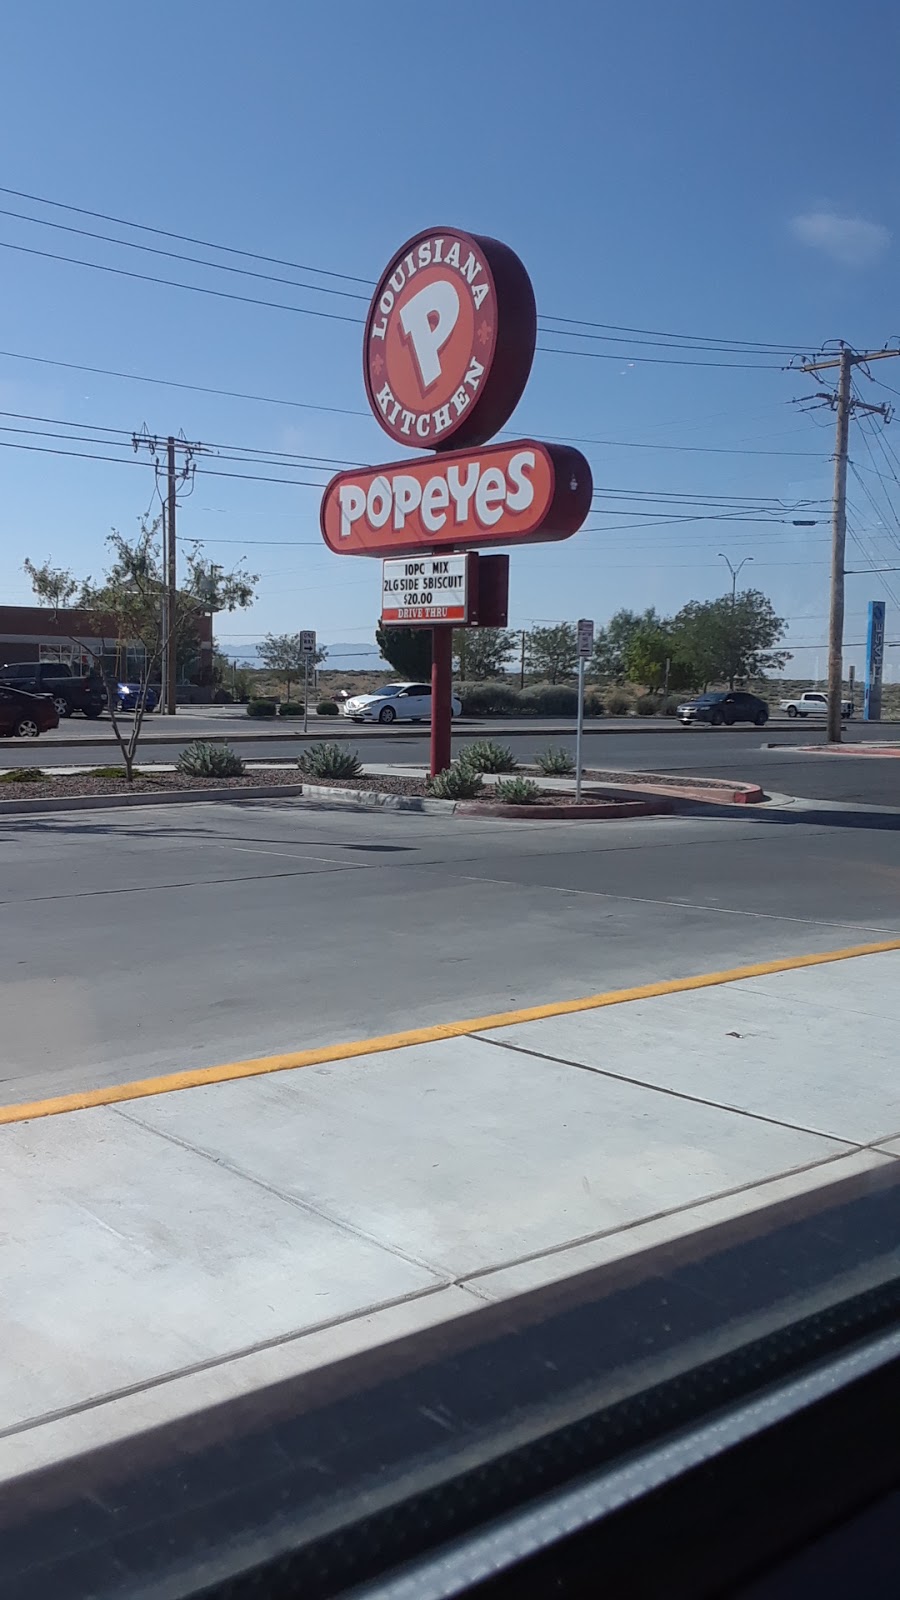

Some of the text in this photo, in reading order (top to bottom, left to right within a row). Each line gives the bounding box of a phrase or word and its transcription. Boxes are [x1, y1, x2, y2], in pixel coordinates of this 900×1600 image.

[372, 239, 489, 340] LOUISIANA
[399, 280, 460, 388] P
[376, 356, 485, 437] KITCHEN
[432, 561, 449, 574] MIX
[397, 607, 448, 618] DRIVE THRU
[403, 592, 433, 605] $20.00
